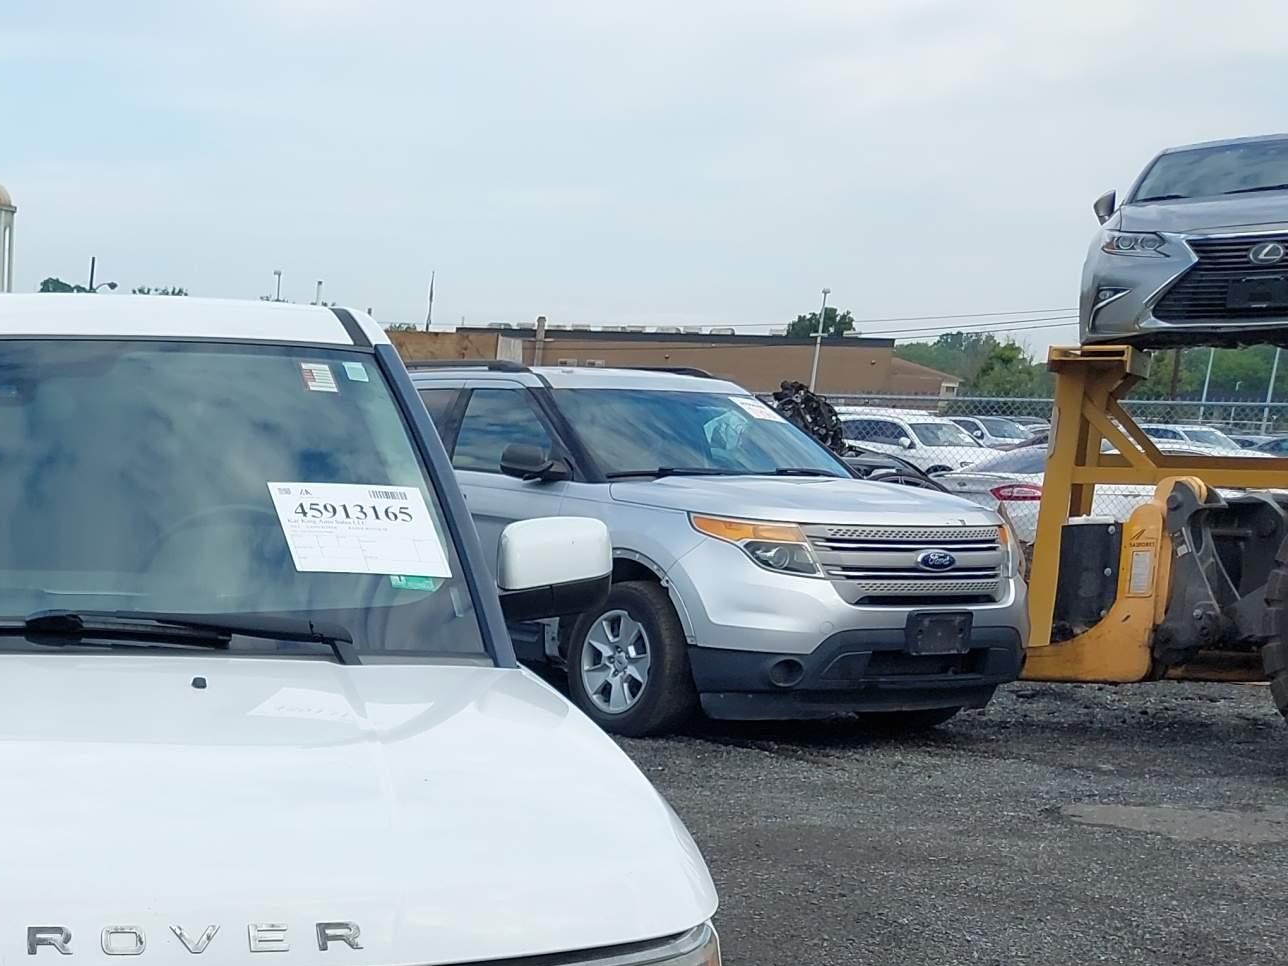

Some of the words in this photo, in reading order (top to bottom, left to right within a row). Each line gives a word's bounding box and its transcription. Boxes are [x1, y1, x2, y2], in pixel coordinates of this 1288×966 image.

[294, 501, 413, 523] 45913165
[928, 553, 950, 565] Ford
[27, 920, 364, 956] ROVER
